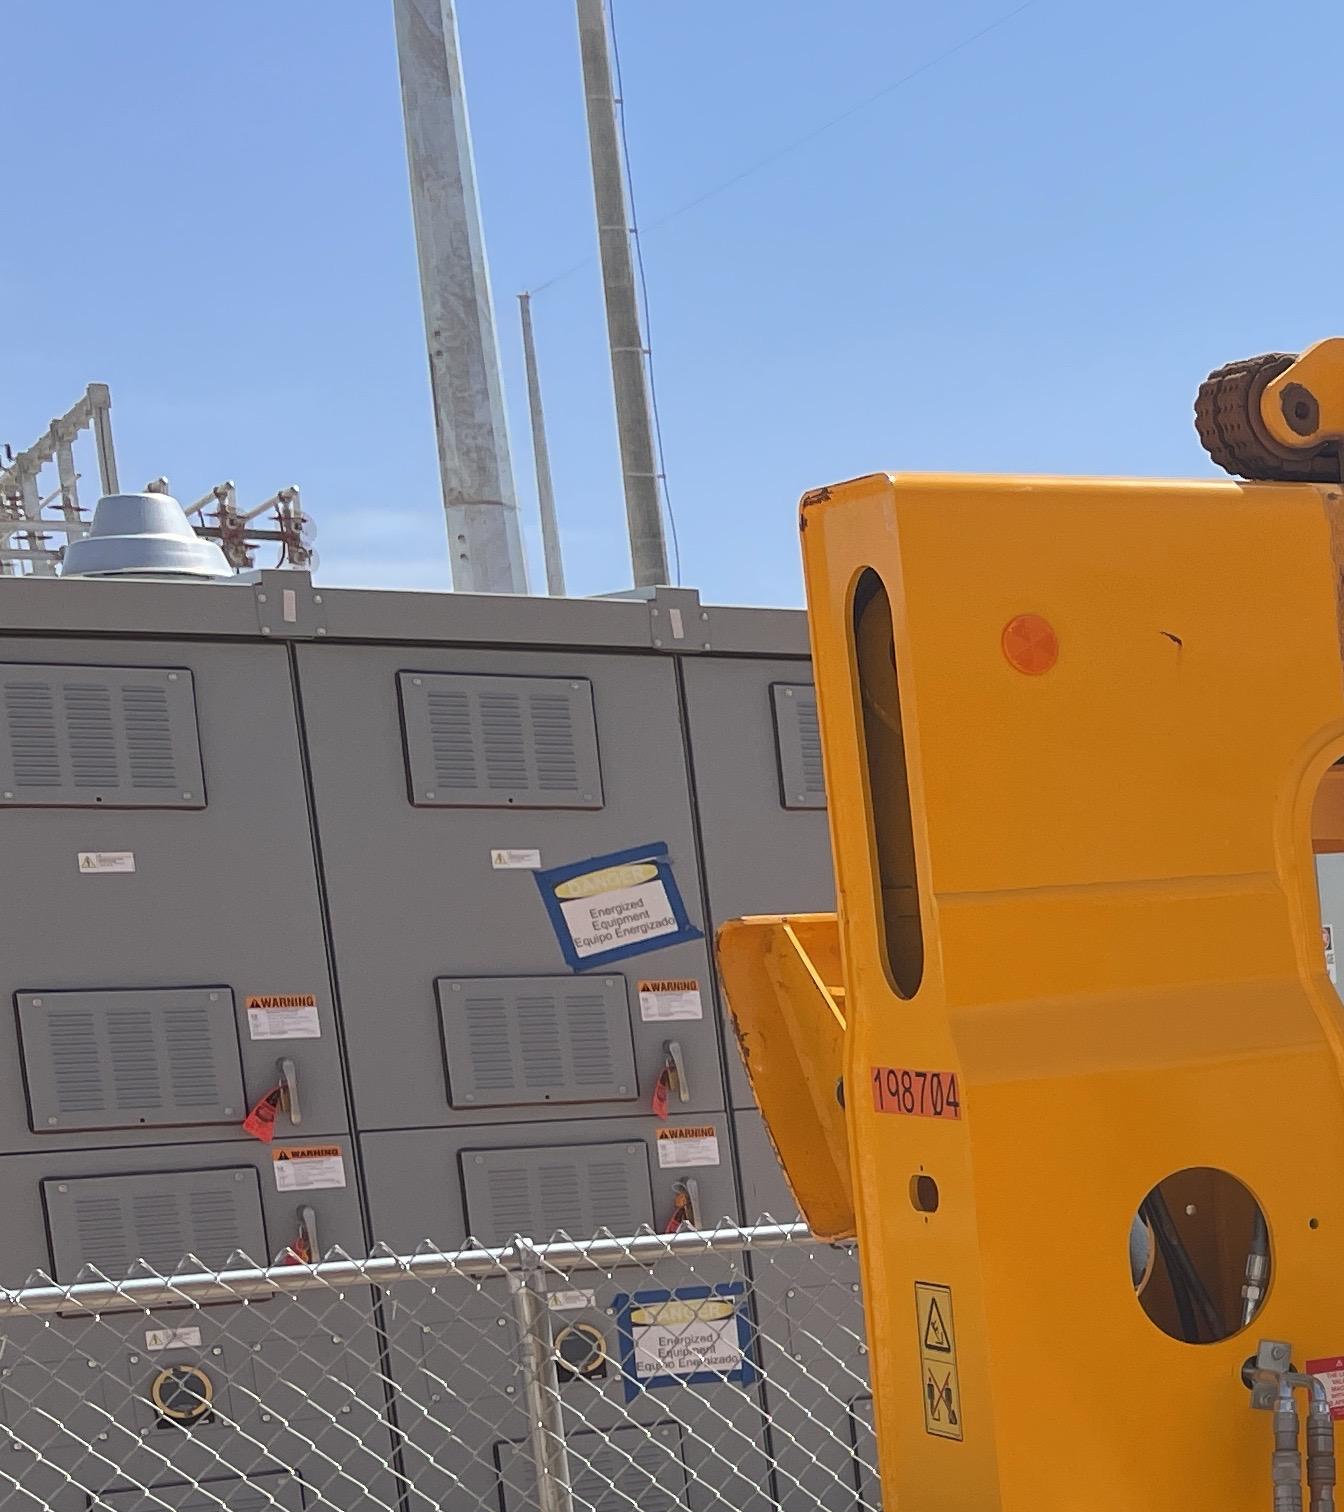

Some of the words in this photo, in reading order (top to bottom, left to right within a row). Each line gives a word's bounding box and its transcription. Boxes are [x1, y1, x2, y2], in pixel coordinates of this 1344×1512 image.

[589, 898, 645, 919] Energized
[592, 910, 650, 932] Equipment
[574, 932, 613, 950] Equipo
[615, 916, 676, 939] Energizado
[651, 981, 697, 992] WARNING
[260, 996, 314, 1008] WARNING
[875, 1067, 960, 1117] 198704
[668, 1128, 714, 1139] WARNING
[291, 1149, 339, 1158] WARNING
